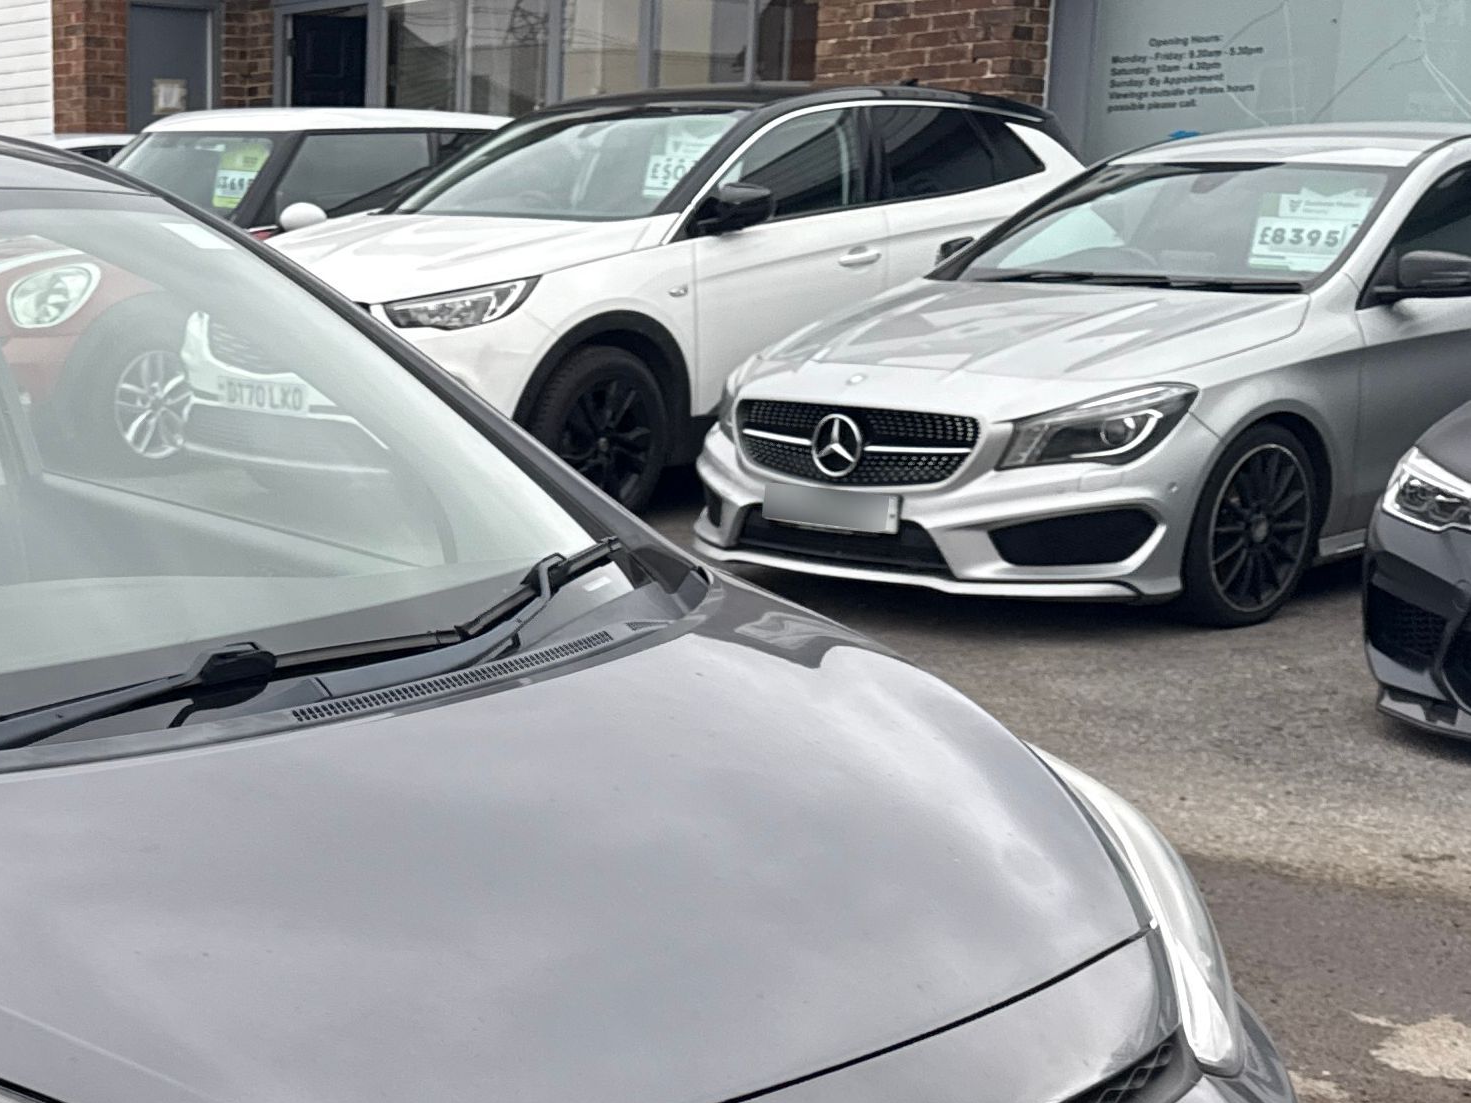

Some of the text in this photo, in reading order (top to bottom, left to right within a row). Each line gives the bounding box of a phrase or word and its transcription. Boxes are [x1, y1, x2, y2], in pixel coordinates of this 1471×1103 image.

[1148, 36, 1189, 47] Opening
[1111, 55, 1147, 64] Monday
[1163, 73, 1225, 85] Appointment
[1226, 84, 1255, 93] hours
[1257, 226, 1341, 248] £8395
